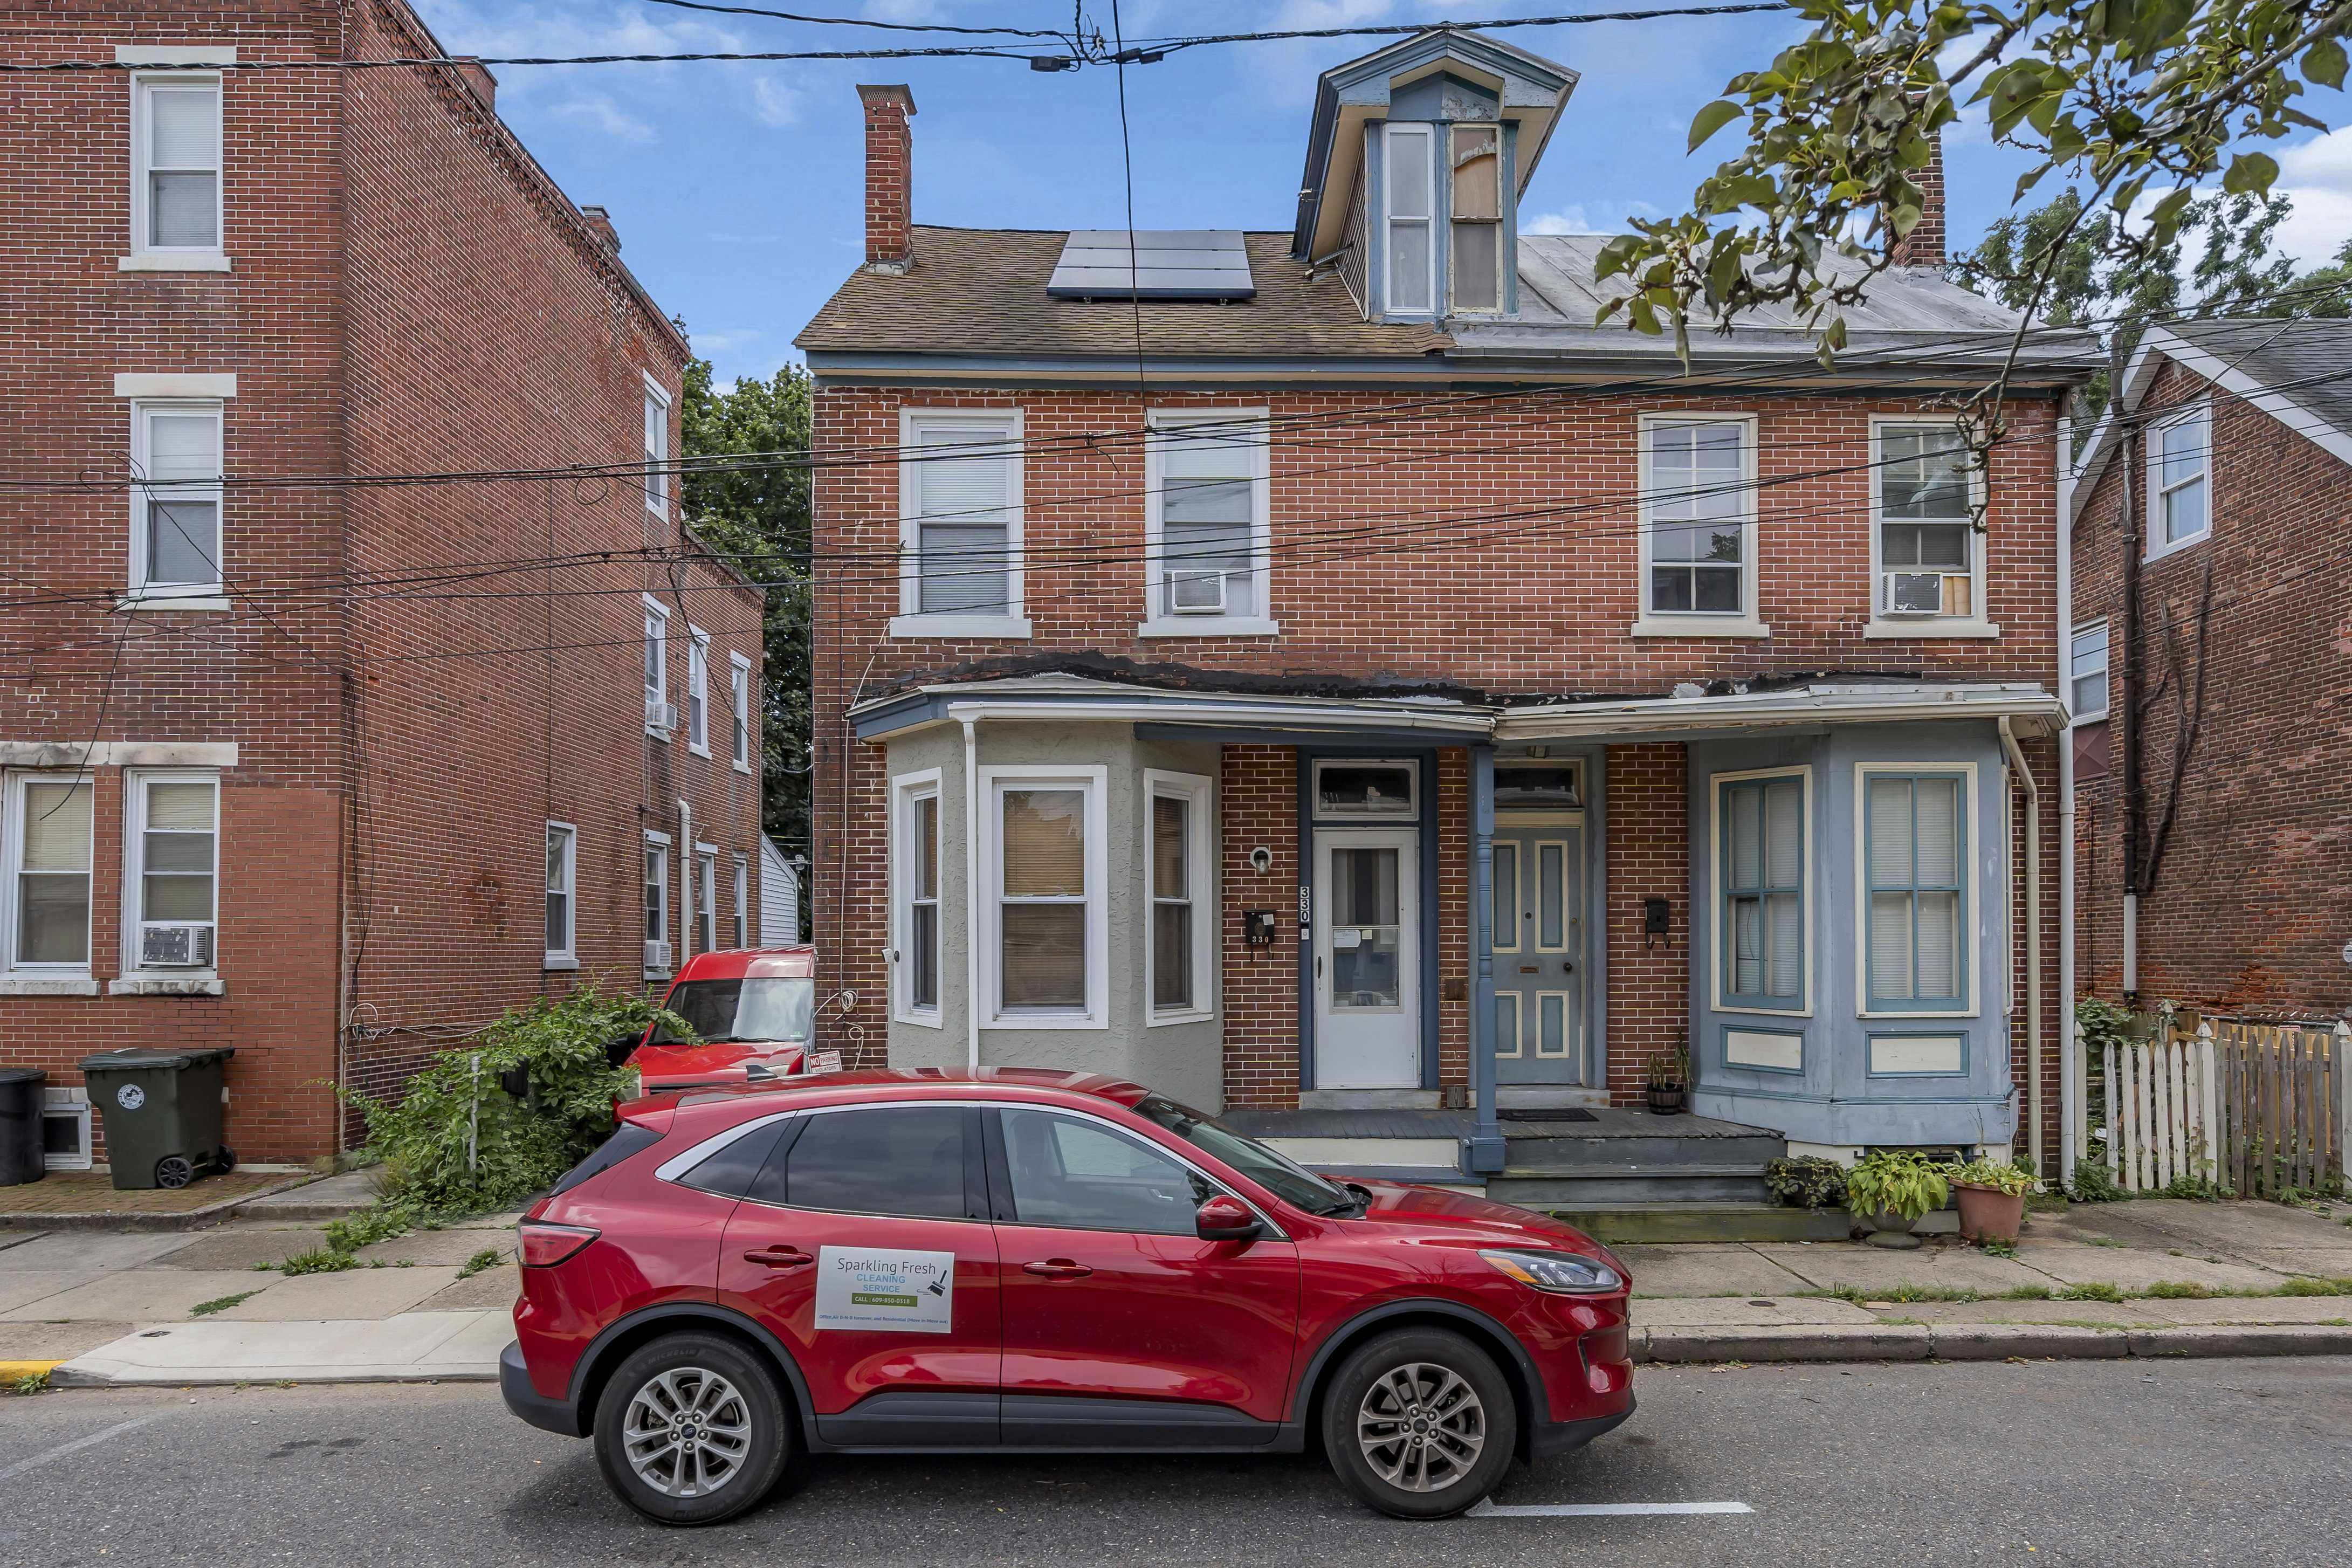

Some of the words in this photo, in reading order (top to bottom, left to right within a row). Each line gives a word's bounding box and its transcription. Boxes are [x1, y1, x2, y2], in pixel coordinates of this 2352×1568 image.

[810, 1057, 820, 1067] NO
[837, 1258, 897, 1275] Sparkling
[902, 1262, 936, 1274] Fresh
[856, 1274, 906, 1283] CLEANING
[863, 1284, 900, 1293] SERVICE
[648, 1349, 696, 1364] MICHELIN
